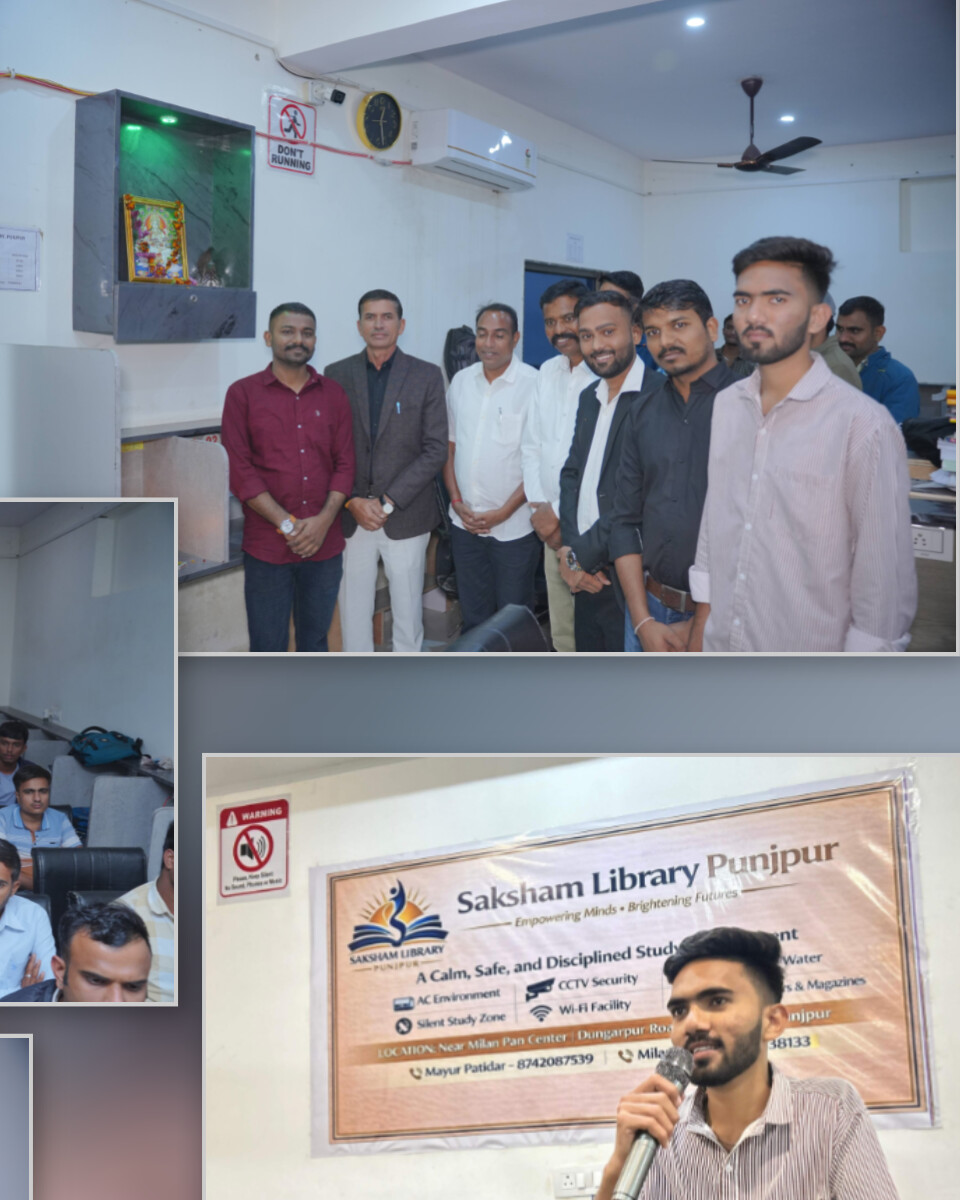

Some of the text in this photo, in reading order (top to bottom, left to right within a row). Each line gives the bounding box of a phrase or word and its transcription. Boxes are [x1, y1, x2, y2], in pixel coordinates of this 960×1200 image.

[277, 145, 304, 158] DON'T
[271, 154, 311, 171] RUNNING
[241, 807, 282, 821] WARNING
[457, 841, 840, 914] Saksham Library Punjpur
[515, 888, 738, 928] Empowering Minds Brightening Futures
[350, 945, 445, 965] SAKSHAM LIBRARY
[783, 953, 823, 966] Water
[416, 946, 631, 984] A Calm, Safe, and Disciplined
[558, 973, 639, 990] CCTV Security
[807, 976, 866, 993] Magazines
[417, 989, 500, 1005] AC Environment
[559, 1000, 631, 1015] Wi-Fi Facility
[417, 1013, 506, 1029] Silent Study Zone
[378, 1025, 645, 1059] LOCATION: Near Milan Pan Center Dungarpur
[425, 1053, 594, 1078] Mayur Patidar 8742087539
